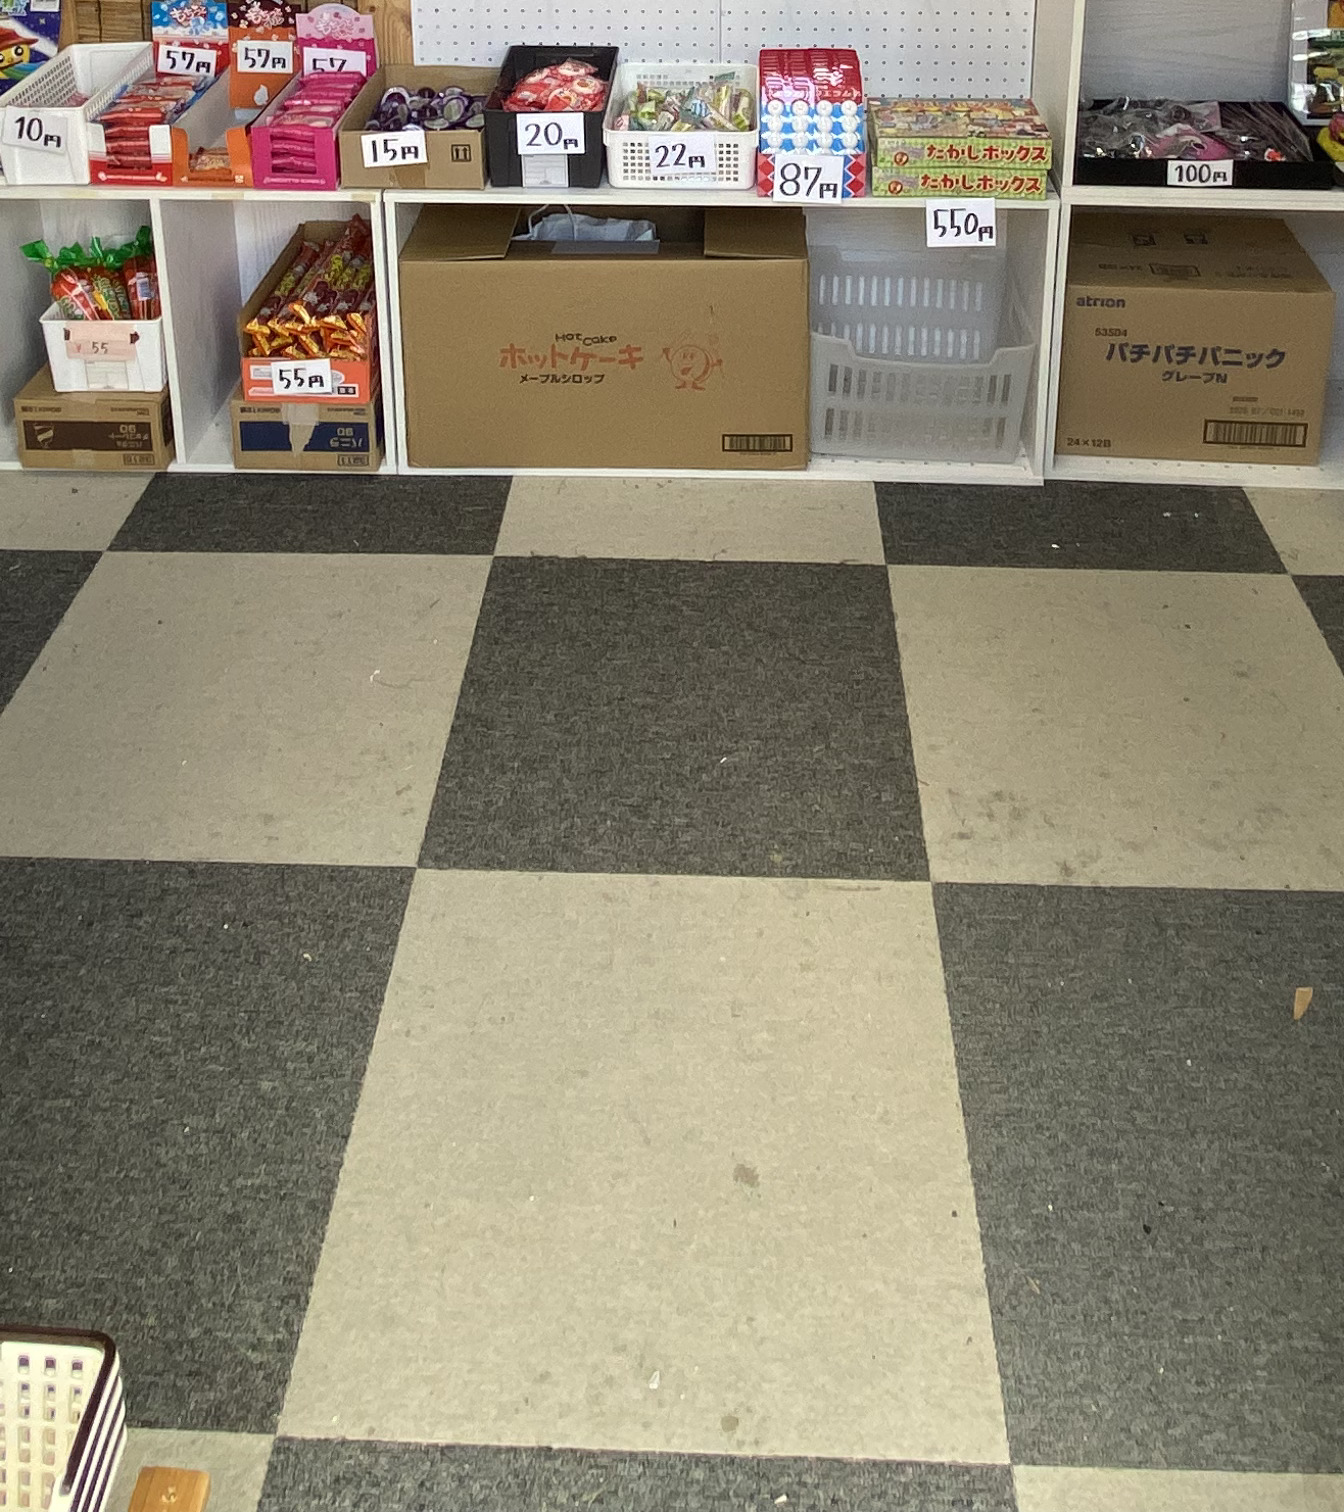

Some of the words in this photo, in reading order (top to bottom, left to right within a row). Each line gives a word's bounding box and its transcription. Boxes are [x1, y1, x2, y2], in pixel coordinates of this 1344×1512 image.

[166, 49, 212, 74] 57円
[243, 47, 287, 69] 57円
[13, 114, 62, 150] 10円
[524, 122, 579, 152] 20円
[370, 138, 419, 163] 15円
[654, 143, 706, 169] 22円
[926, 143, 1048, 163] たかしボックス
[779, 161, 838, 200] 87円
[920, 173, 1043, 194] たかしボックス
[1172, 162, 1229, 185] 100円
[932, 207, 995, 243] 550円
[1076, 295, 1126, 309] atrion
[499, 343, 644, 371] ホットケーキ
[278, 367, 325, 390] 55円
[518, 373, 606, 385] メープルシロップ
